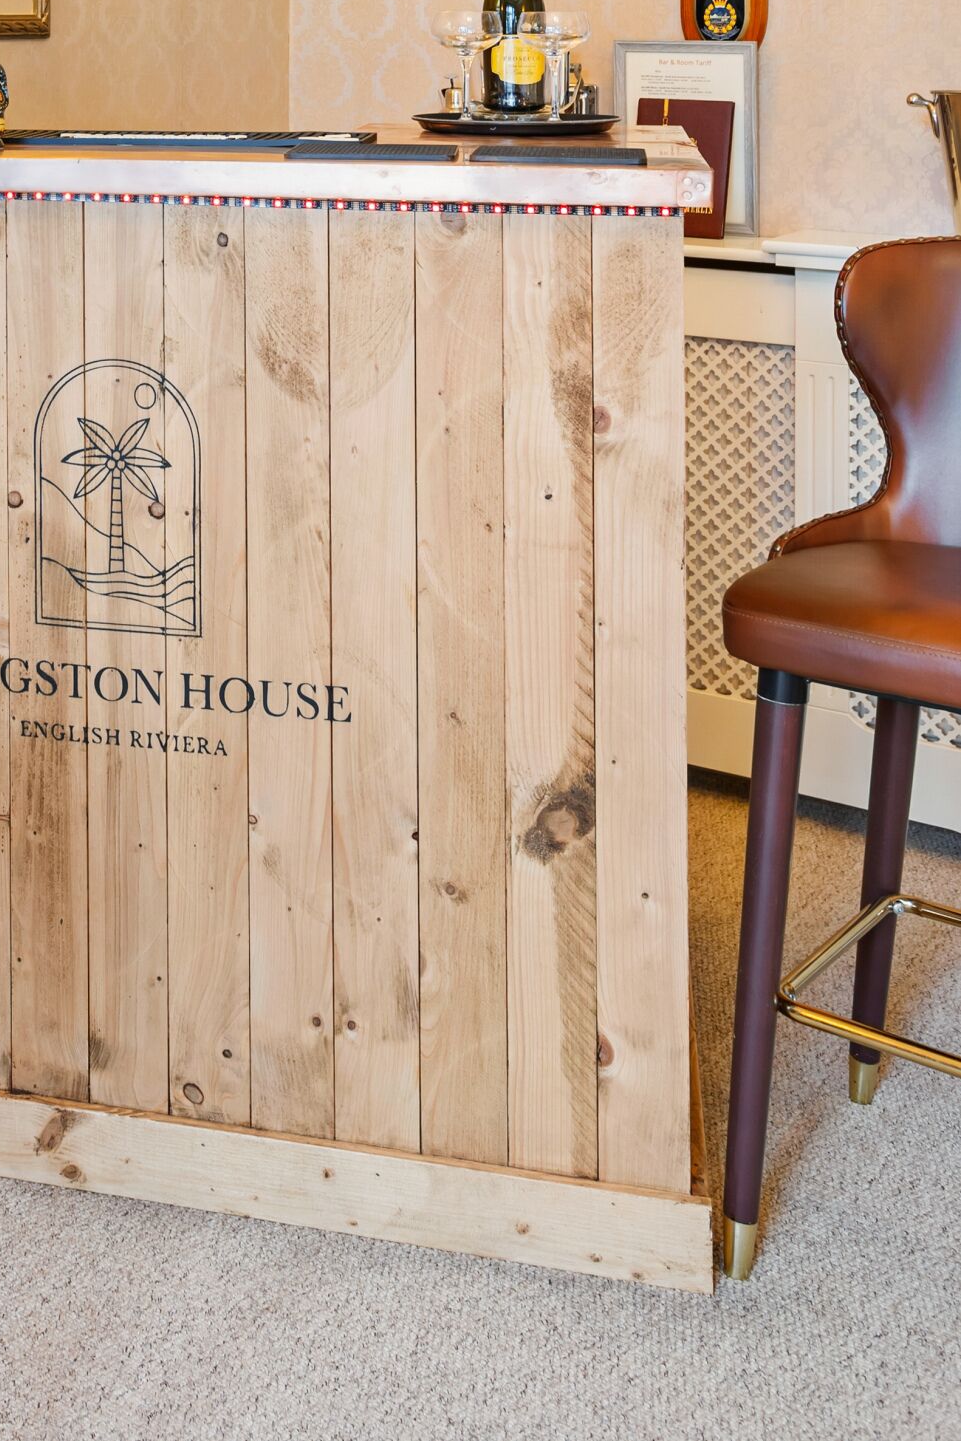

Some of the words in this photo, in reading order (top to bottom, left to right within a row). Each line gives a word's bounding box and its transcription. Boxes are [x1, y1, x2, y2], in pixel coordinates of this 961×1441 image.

[180, 673, 353, 723] HOUSE
[20, 720, 121, 747] ENGLISH
[130, 731, 228, 757] RIVIERA
